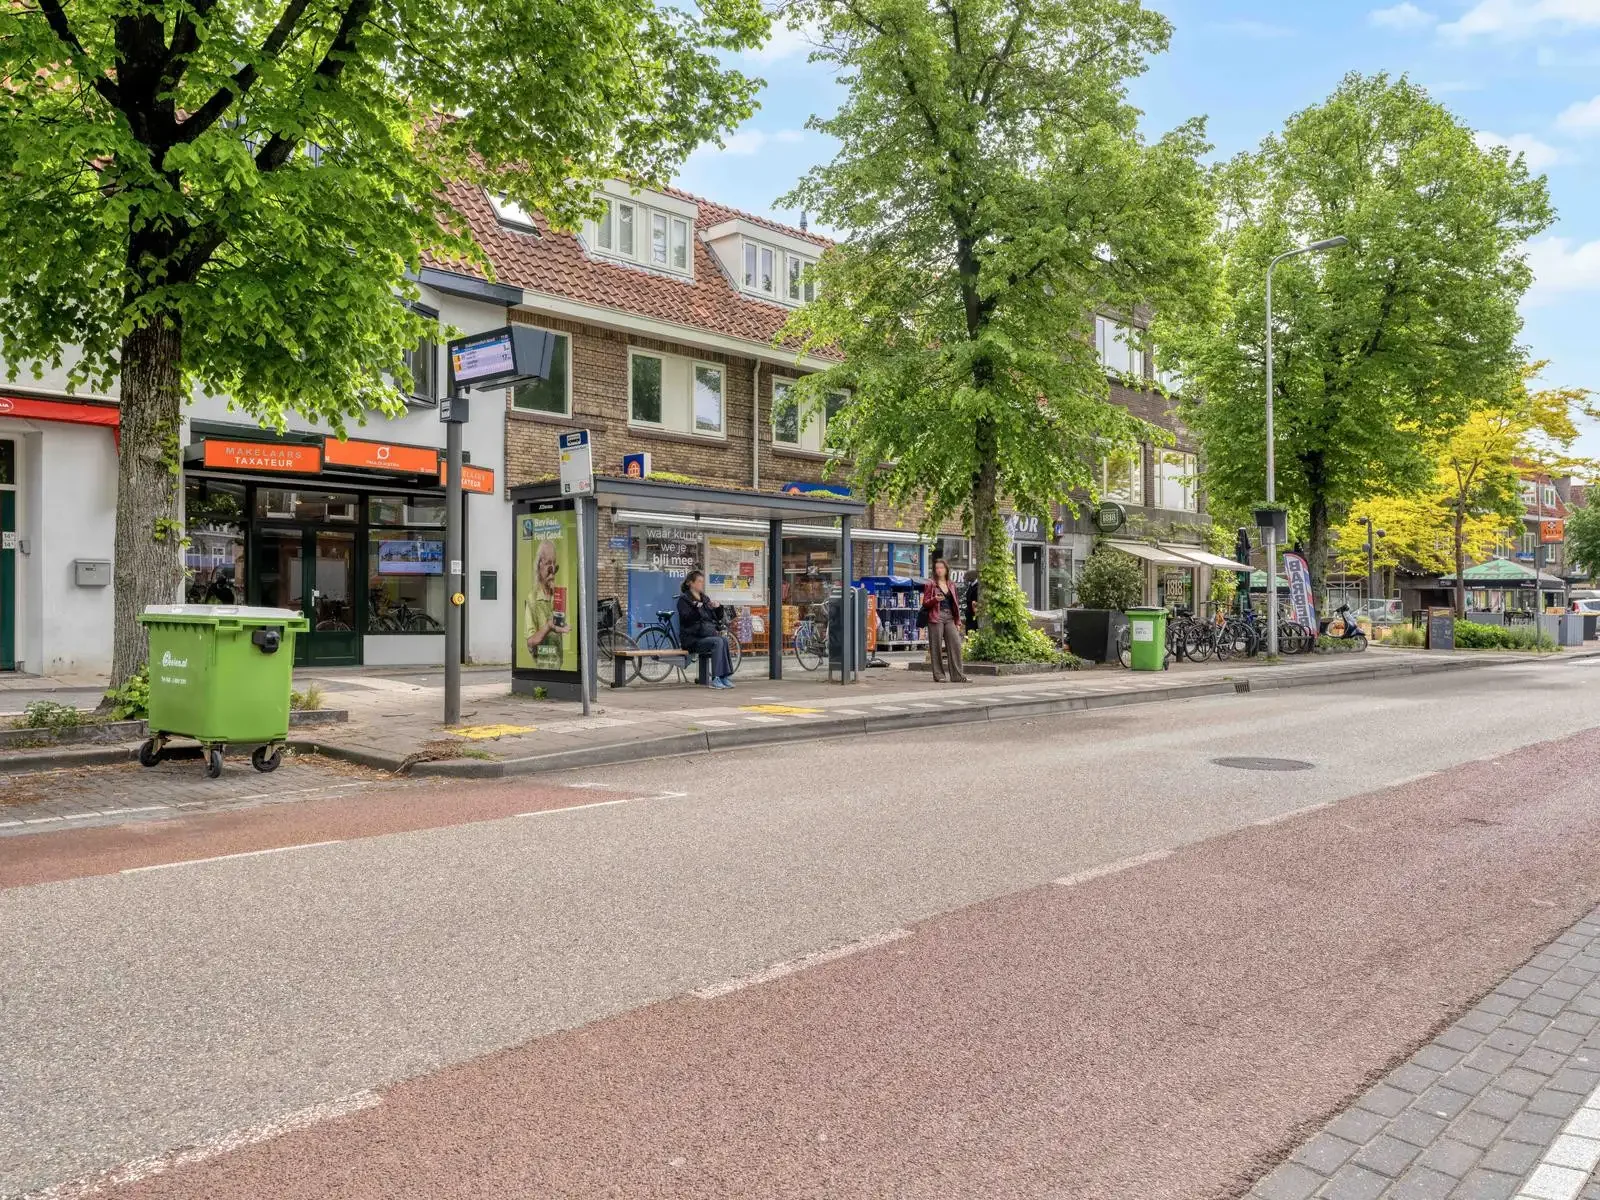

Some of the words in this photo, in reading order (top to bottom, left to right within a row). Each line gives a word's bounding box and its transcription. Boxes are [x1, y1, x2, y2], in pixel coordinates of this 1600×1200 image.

[225, 447, 302, 459] MAKELAARS
[235, 456, 293, 467] TAXATEUR
[1102, 512, 1117, 522] 1818
[647, 530, 671, 539] waar
[674, 529, 704, 541] kunne
[661, 543, 676, 552] we
[677, 543, 687, 555] je
[653, 553, 669, 567] blij
[671, 556, 693, 566] mee
[1166, 579, 1183, 596] 1818
[1289, 560, 1310, 627] BARBER
